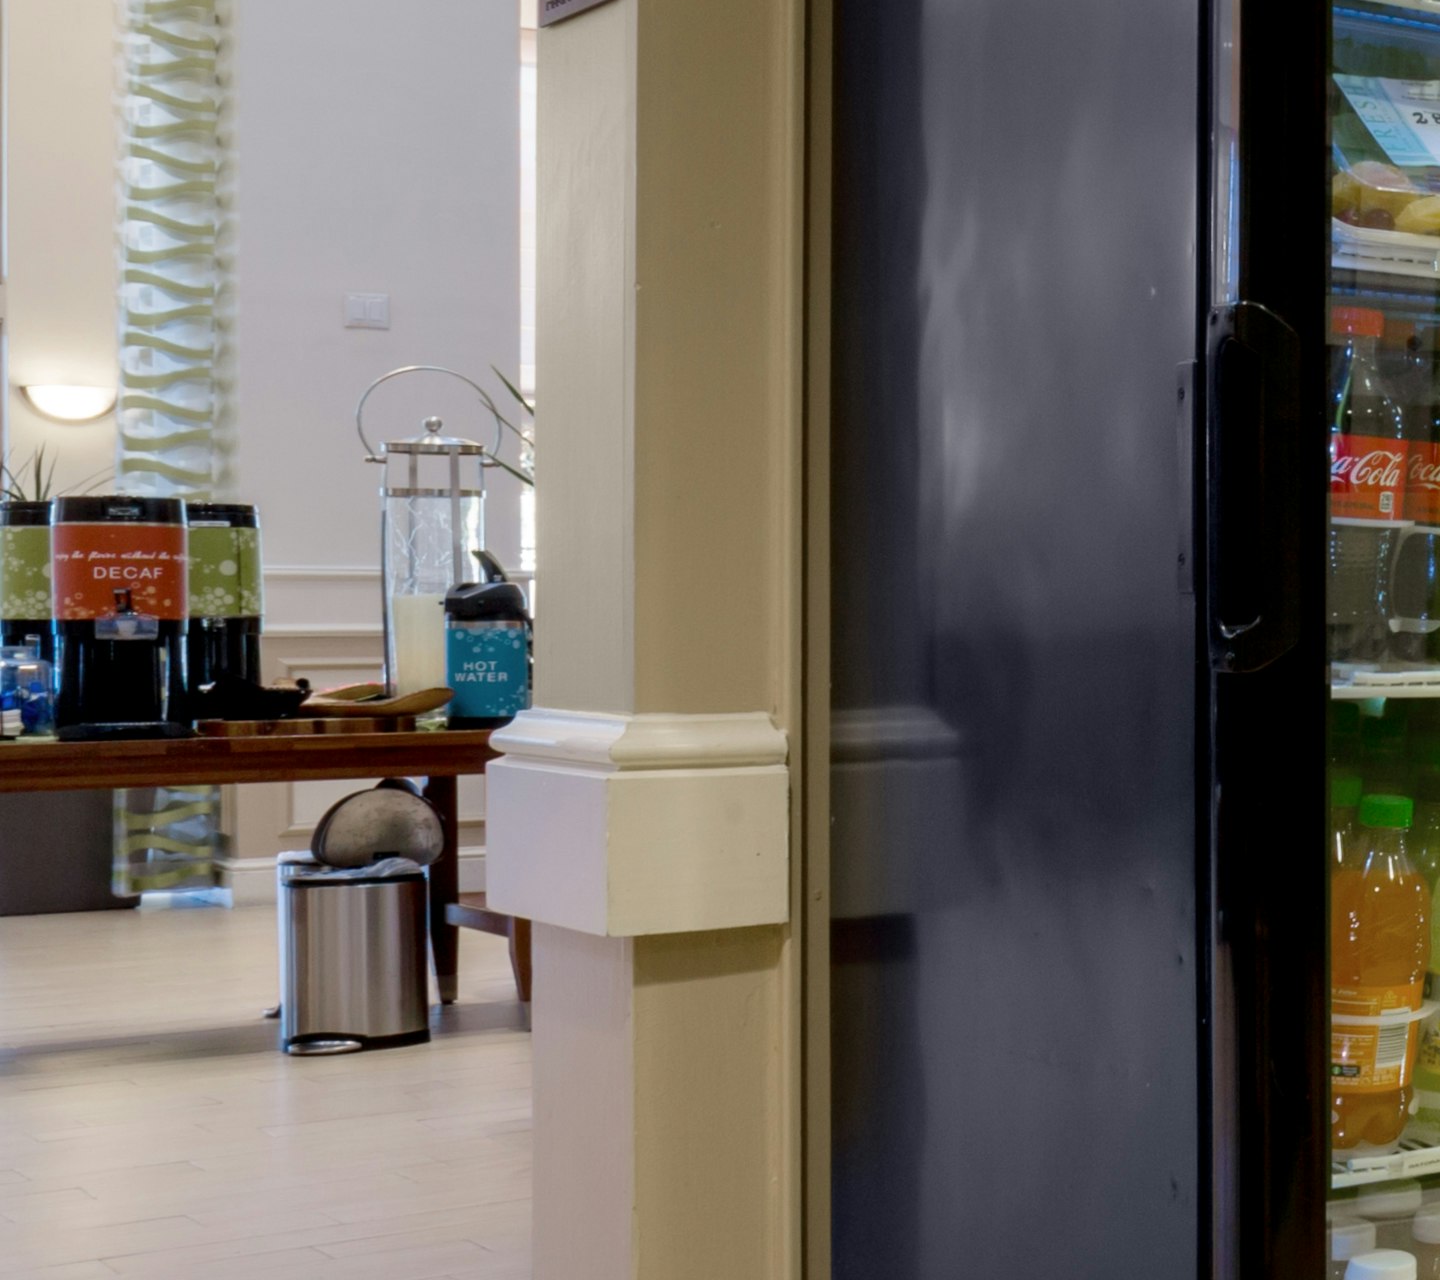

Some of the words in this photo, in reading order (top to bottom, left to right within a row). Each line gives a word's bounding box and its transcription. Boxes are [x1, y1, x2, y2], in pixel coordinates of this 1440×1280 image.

[93, 566, 163, 579] DECAF
[463, 661, 497, 672] HOT
[455, 671, 508, 683] WATER
